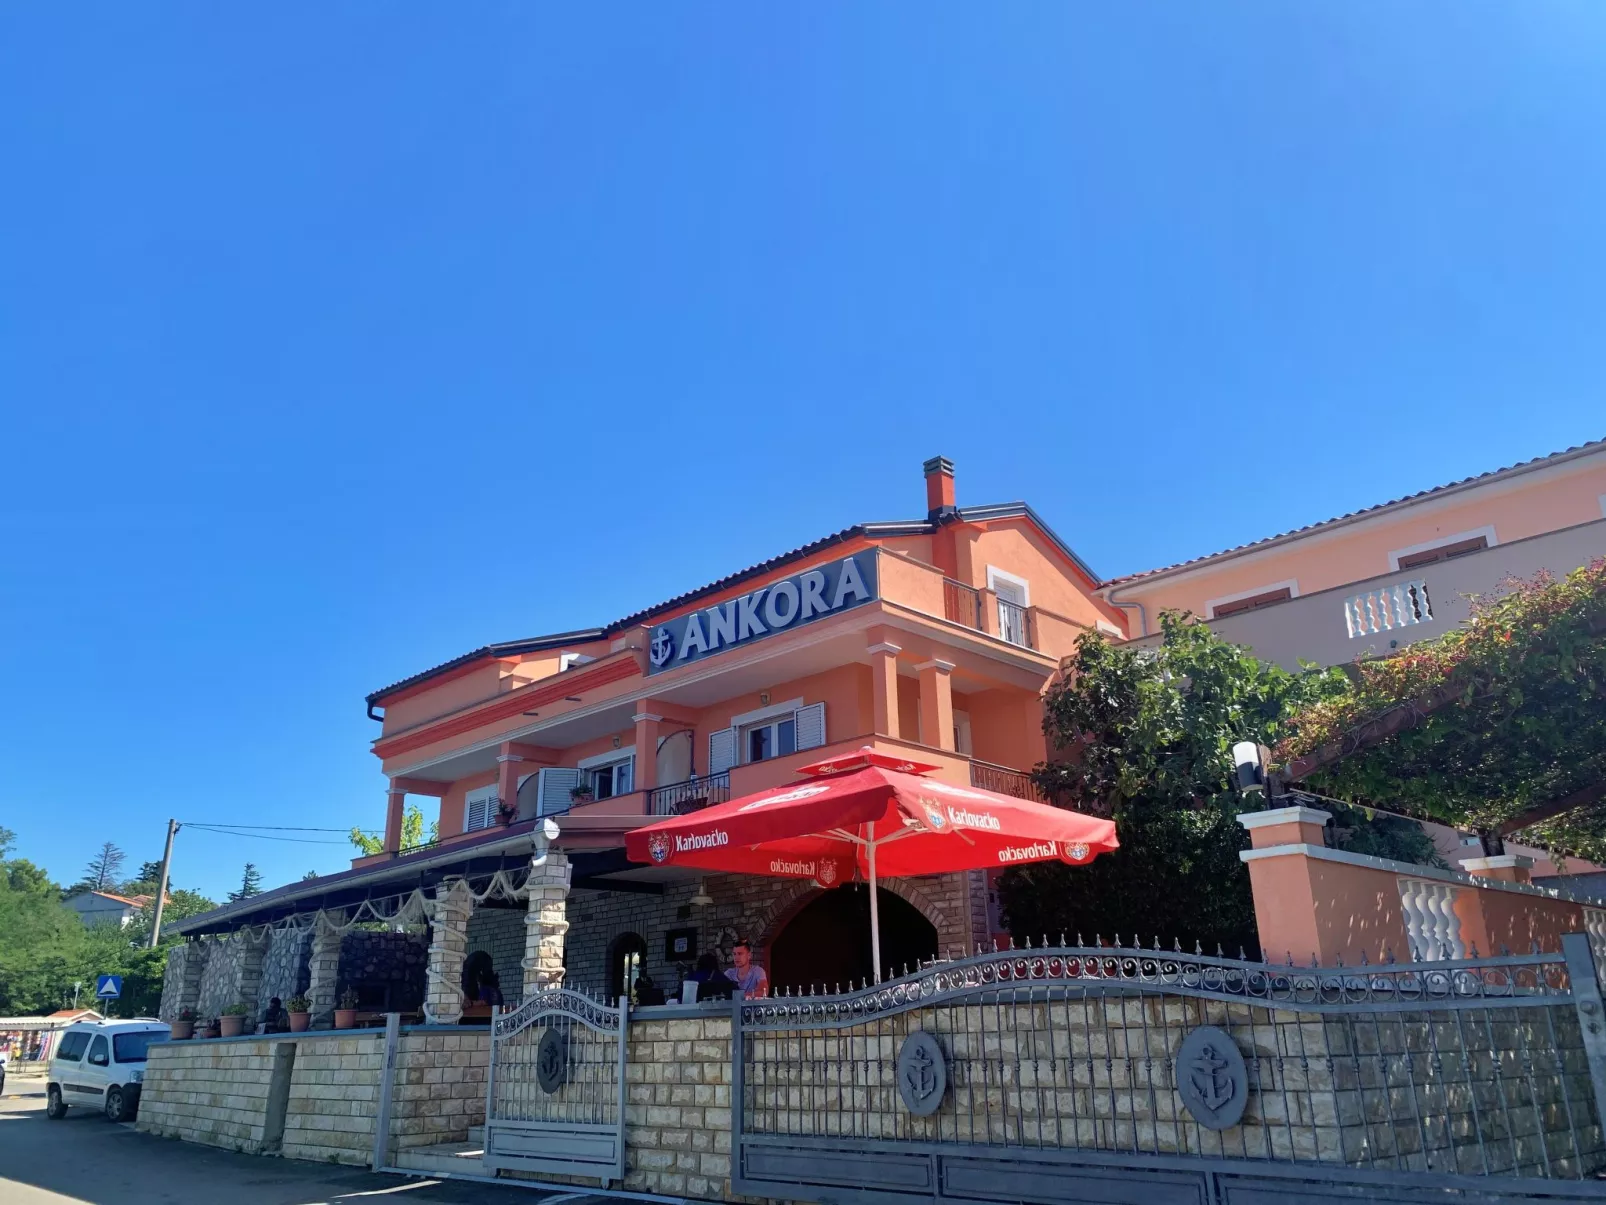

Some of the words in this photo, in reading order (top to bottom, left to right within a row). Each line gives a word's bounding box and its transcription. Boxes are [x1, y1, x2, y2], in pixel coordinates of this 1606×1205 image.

[677, 556, 870, 660] ANKORA
[947, 806, 1001, 830] Karlovačko
[676, 828, 728, 852] Karlovačko
